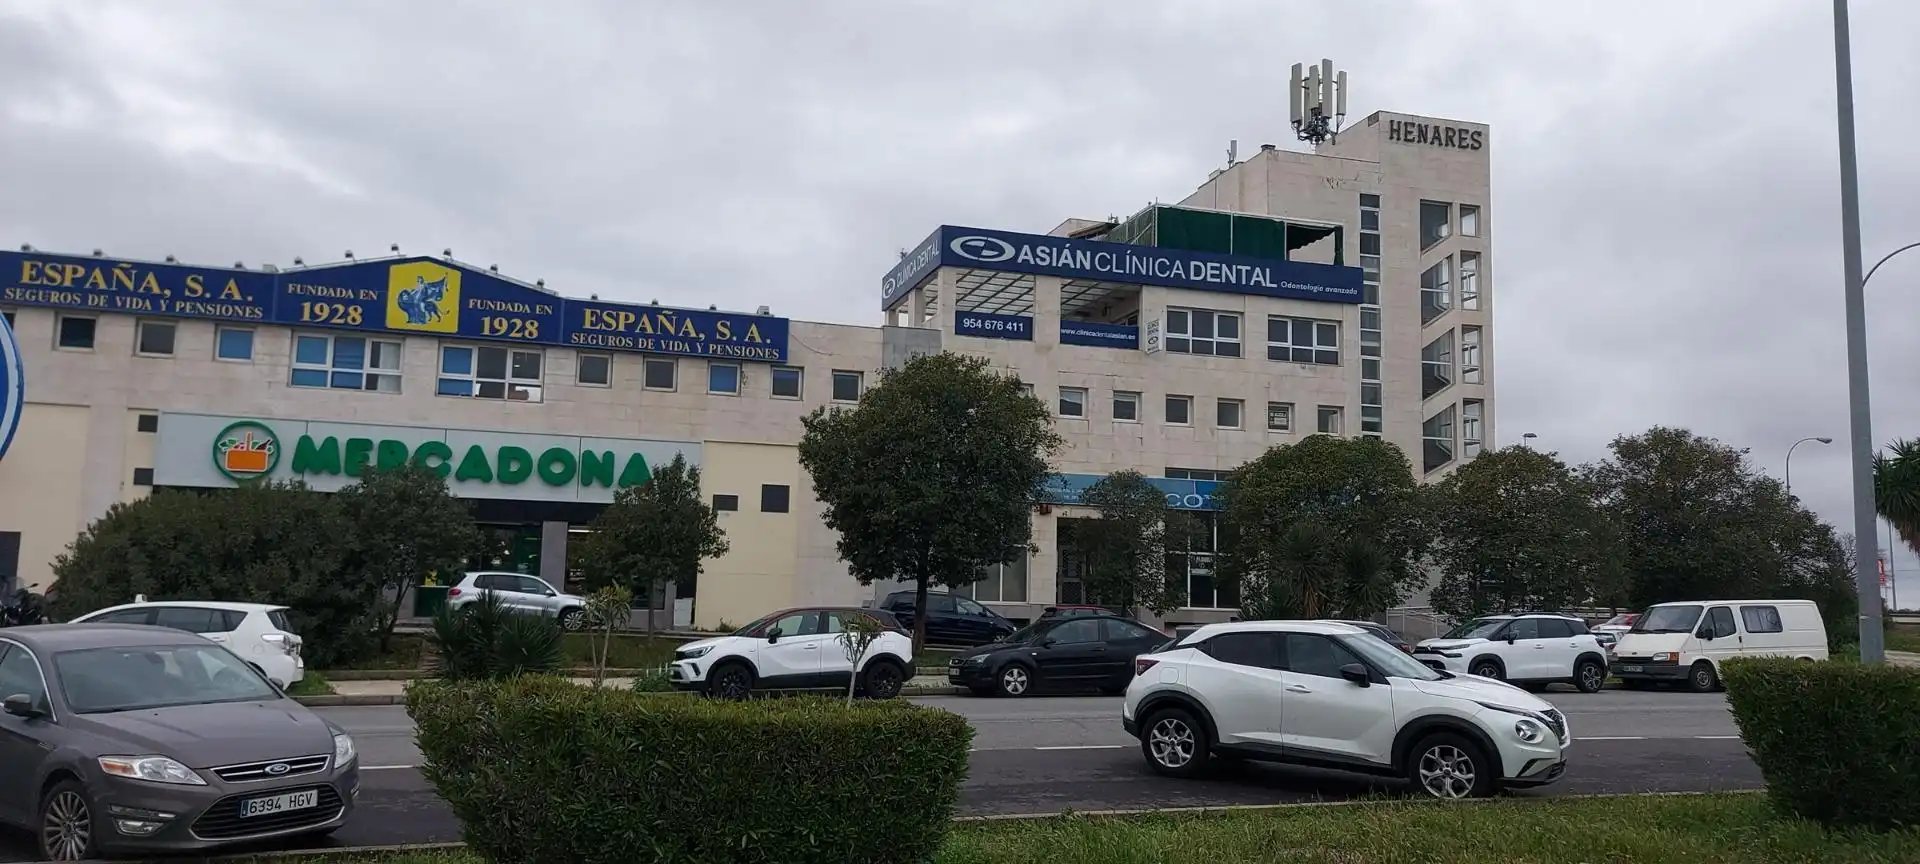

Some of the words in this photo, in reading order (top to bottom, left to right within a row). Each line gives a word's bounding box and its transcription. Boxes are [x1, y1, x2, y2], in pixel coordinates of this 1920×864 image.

[1388, 119, 1482, 150] HENARES
[917, 239, 940, 271] DENTAL
[1017, 243, 1091, 270] ASIÁN
[1094, 249, 1186, 281] CLÍNICA
[1190, 260, 1278, 288] DENTAL
[20, 260, 171, 298] ESPAÑA,
[287, 283, 354, 300] FUNDADA
[360, 289, 378, 301] EN
[4, 287, 82, 306] SEGUROS
[87, 292, 109, 308] DE
[115, 296, 152, 310] VIDA
[159, 299, 170, 312] Y
[175, 301, 263, 319] PENSIONES
[300, 301, 363, 326] 1928
[468, 298, 531, 315] FUNDADA
[535, 304, 553, 316] EN
[481, 316, 539, 339] 1928
[582, 308, 706, 342] ESPAÑA,
[963, 318, 982, 329] 954
[984, 319, 1004, 331] 676
[1006, 321, 1024, 332] 411
[571, 332, 633, 348] SEGUROS
[638, 338, 656, 350] DE
[660, 340, 691, 353] VIDA
[696, 343, 705, 354] Y
[708, 343, 780, 360] PENSIONES
[291, 434, 652, 489] MERCADONA
[249, 797, 281, 813] 6394
[289, 793, 312, 808] HGV
